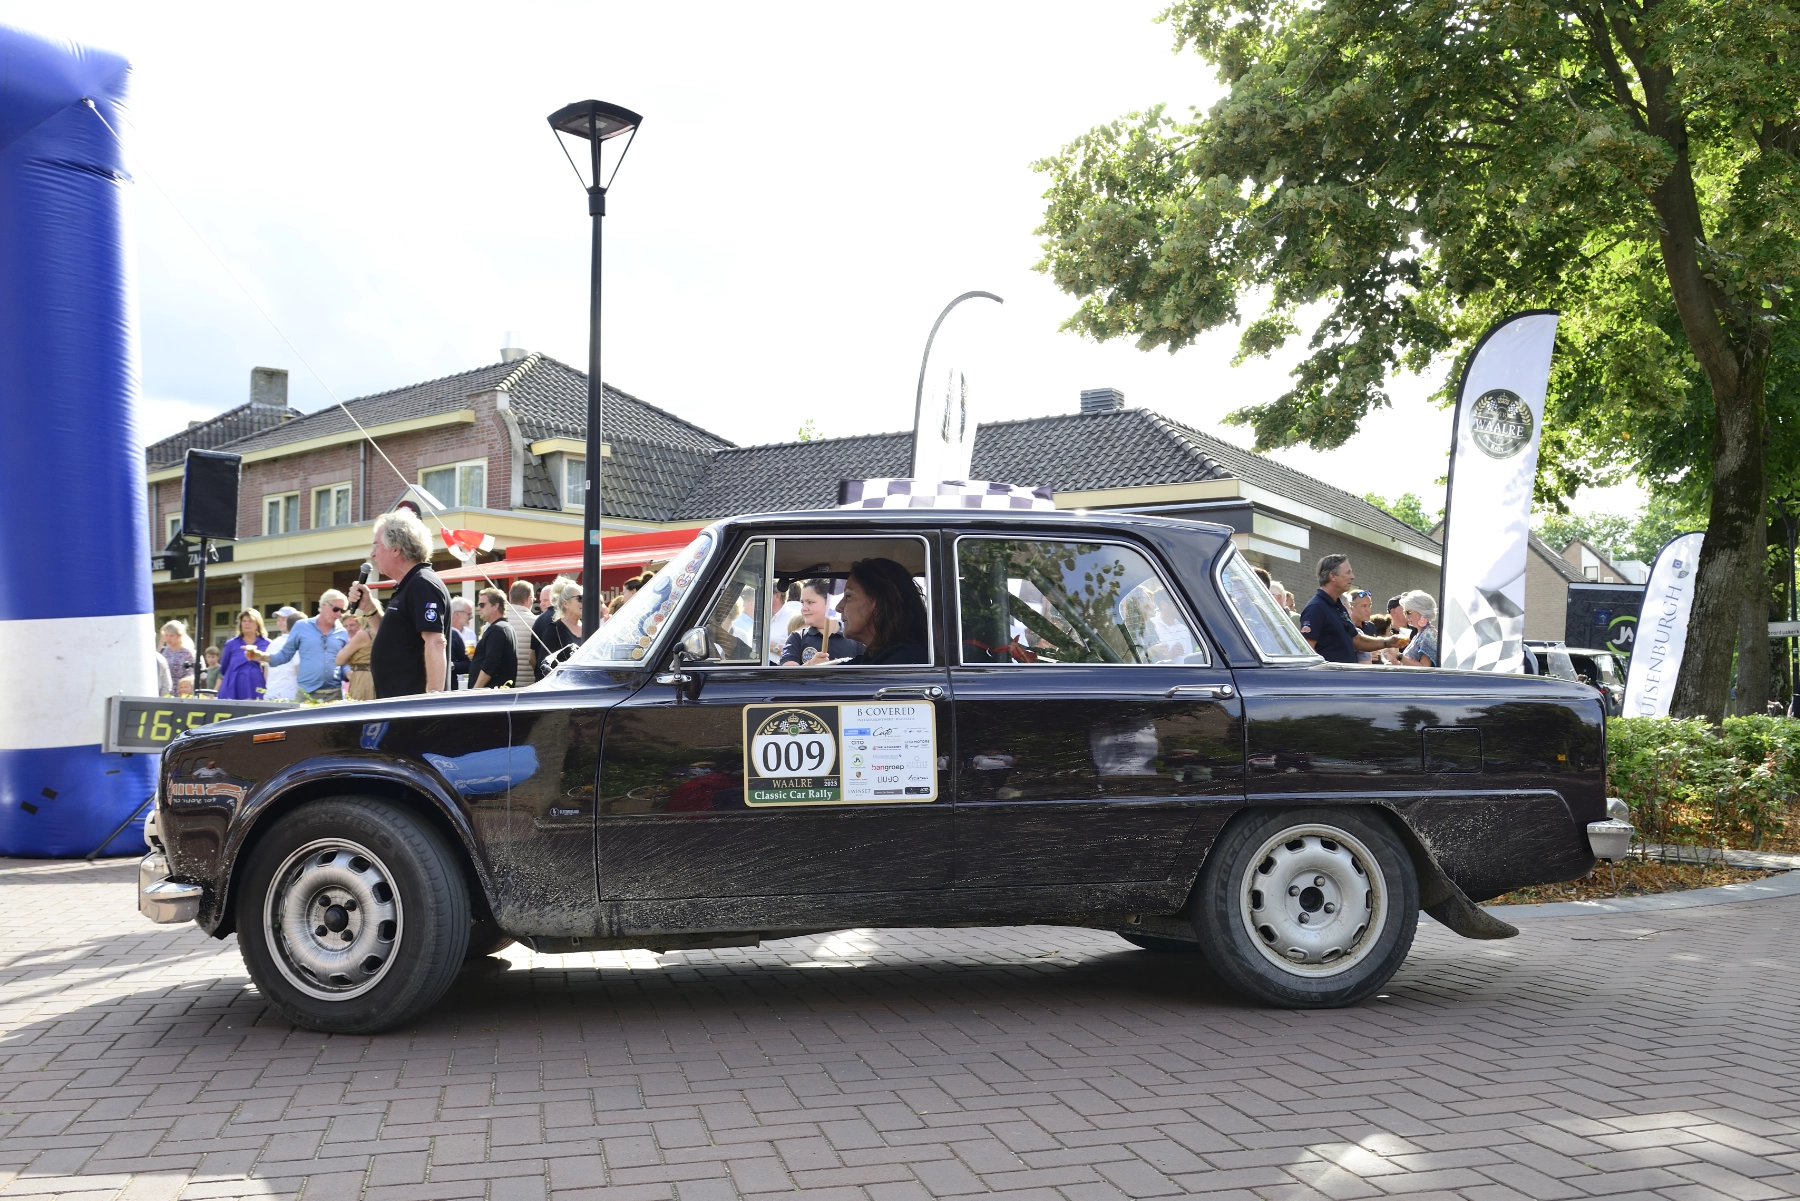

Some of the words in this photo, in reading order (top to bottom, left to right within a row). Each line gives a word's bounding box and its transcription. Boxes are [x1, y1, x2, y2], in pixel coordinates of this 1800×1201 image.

[1475, 419, 1524, 437] WAALRE
[866, 707, 915, 716] COVERED
[762, 740, 825, 772] 009
[772, 778, 813, 788] WAALRE
[754, 791, 787, 800] Classic
[789, 791, 806, 799] Car
[808, 789, 833, 800] Rally
